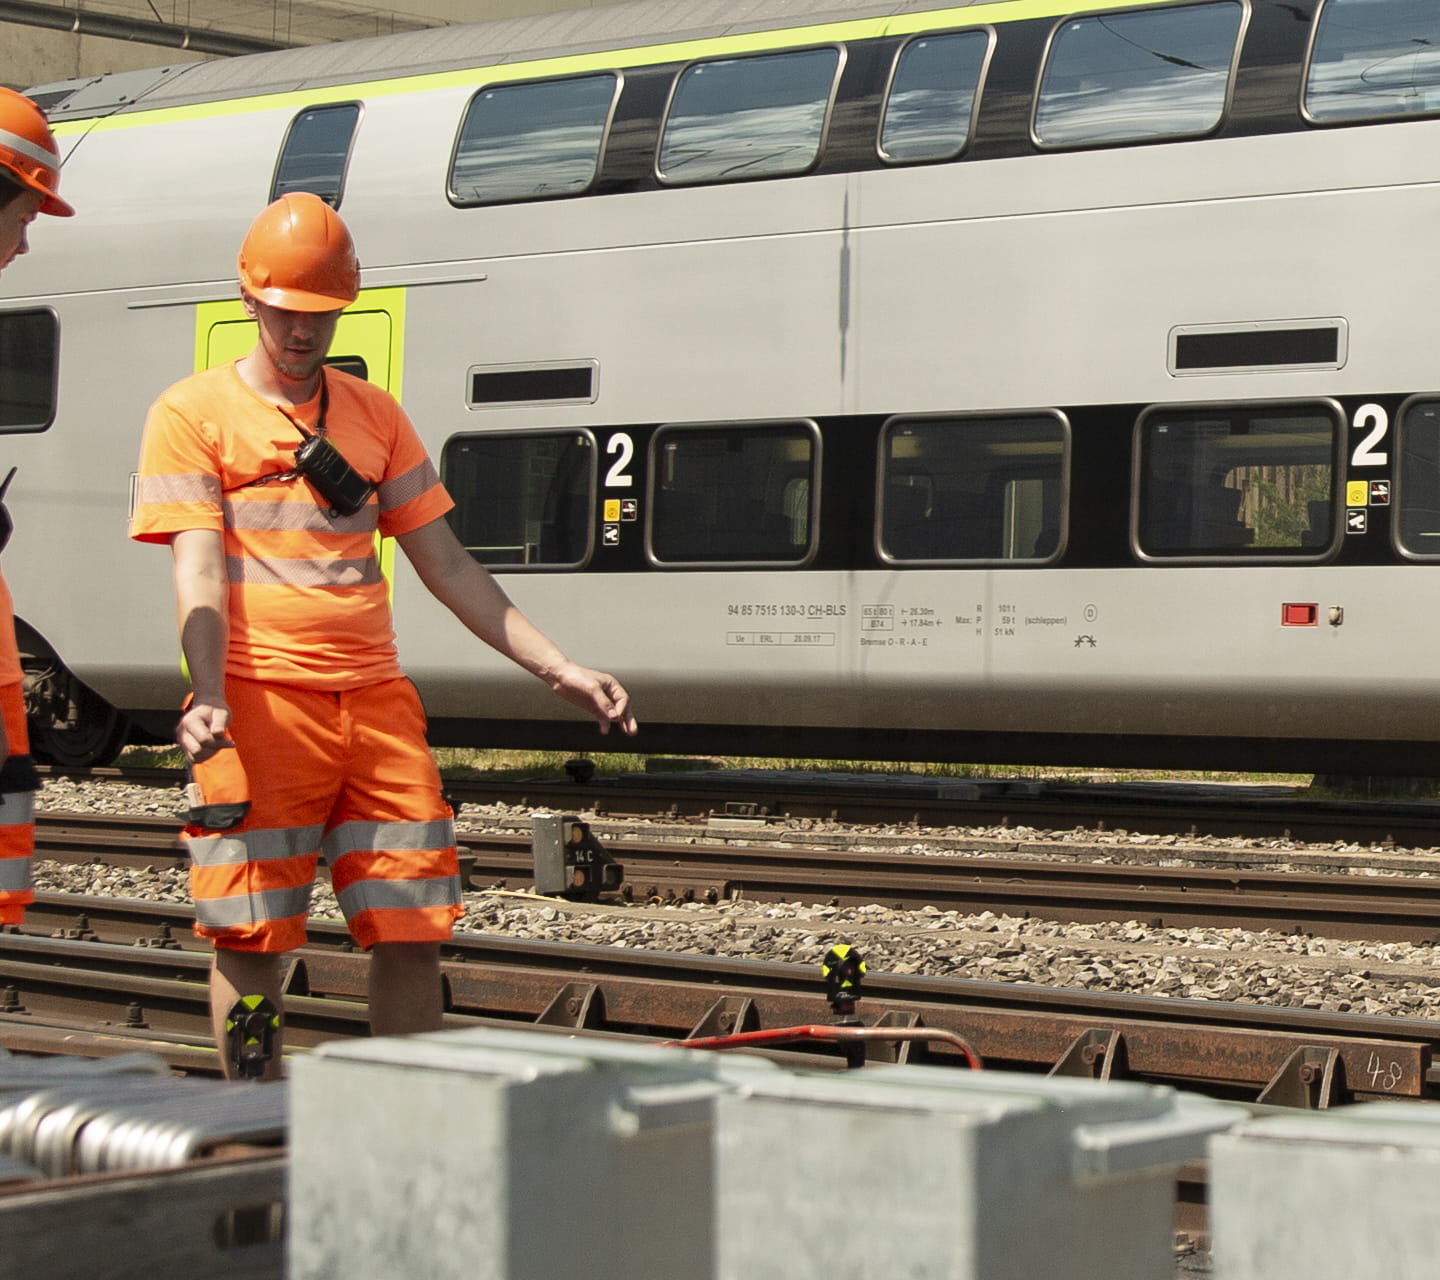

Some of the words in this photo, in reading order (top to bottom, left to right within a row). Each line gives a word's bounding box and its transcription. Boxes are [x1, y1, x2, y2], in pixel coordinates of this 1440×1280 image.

[1351, 403, 1388, 466] 2
[605, 432, 634, 487] 2
[728, 605, 739, 616] 94
[741, 605, 753, 616] 85
[755, 605, 778, 616] 7515
[780, 605, 806, 616] 130-3
[807, 605, 847, 617] CH-BLS
[575, 850, 585, 863] 14
[587, 850, 593, 862] C
